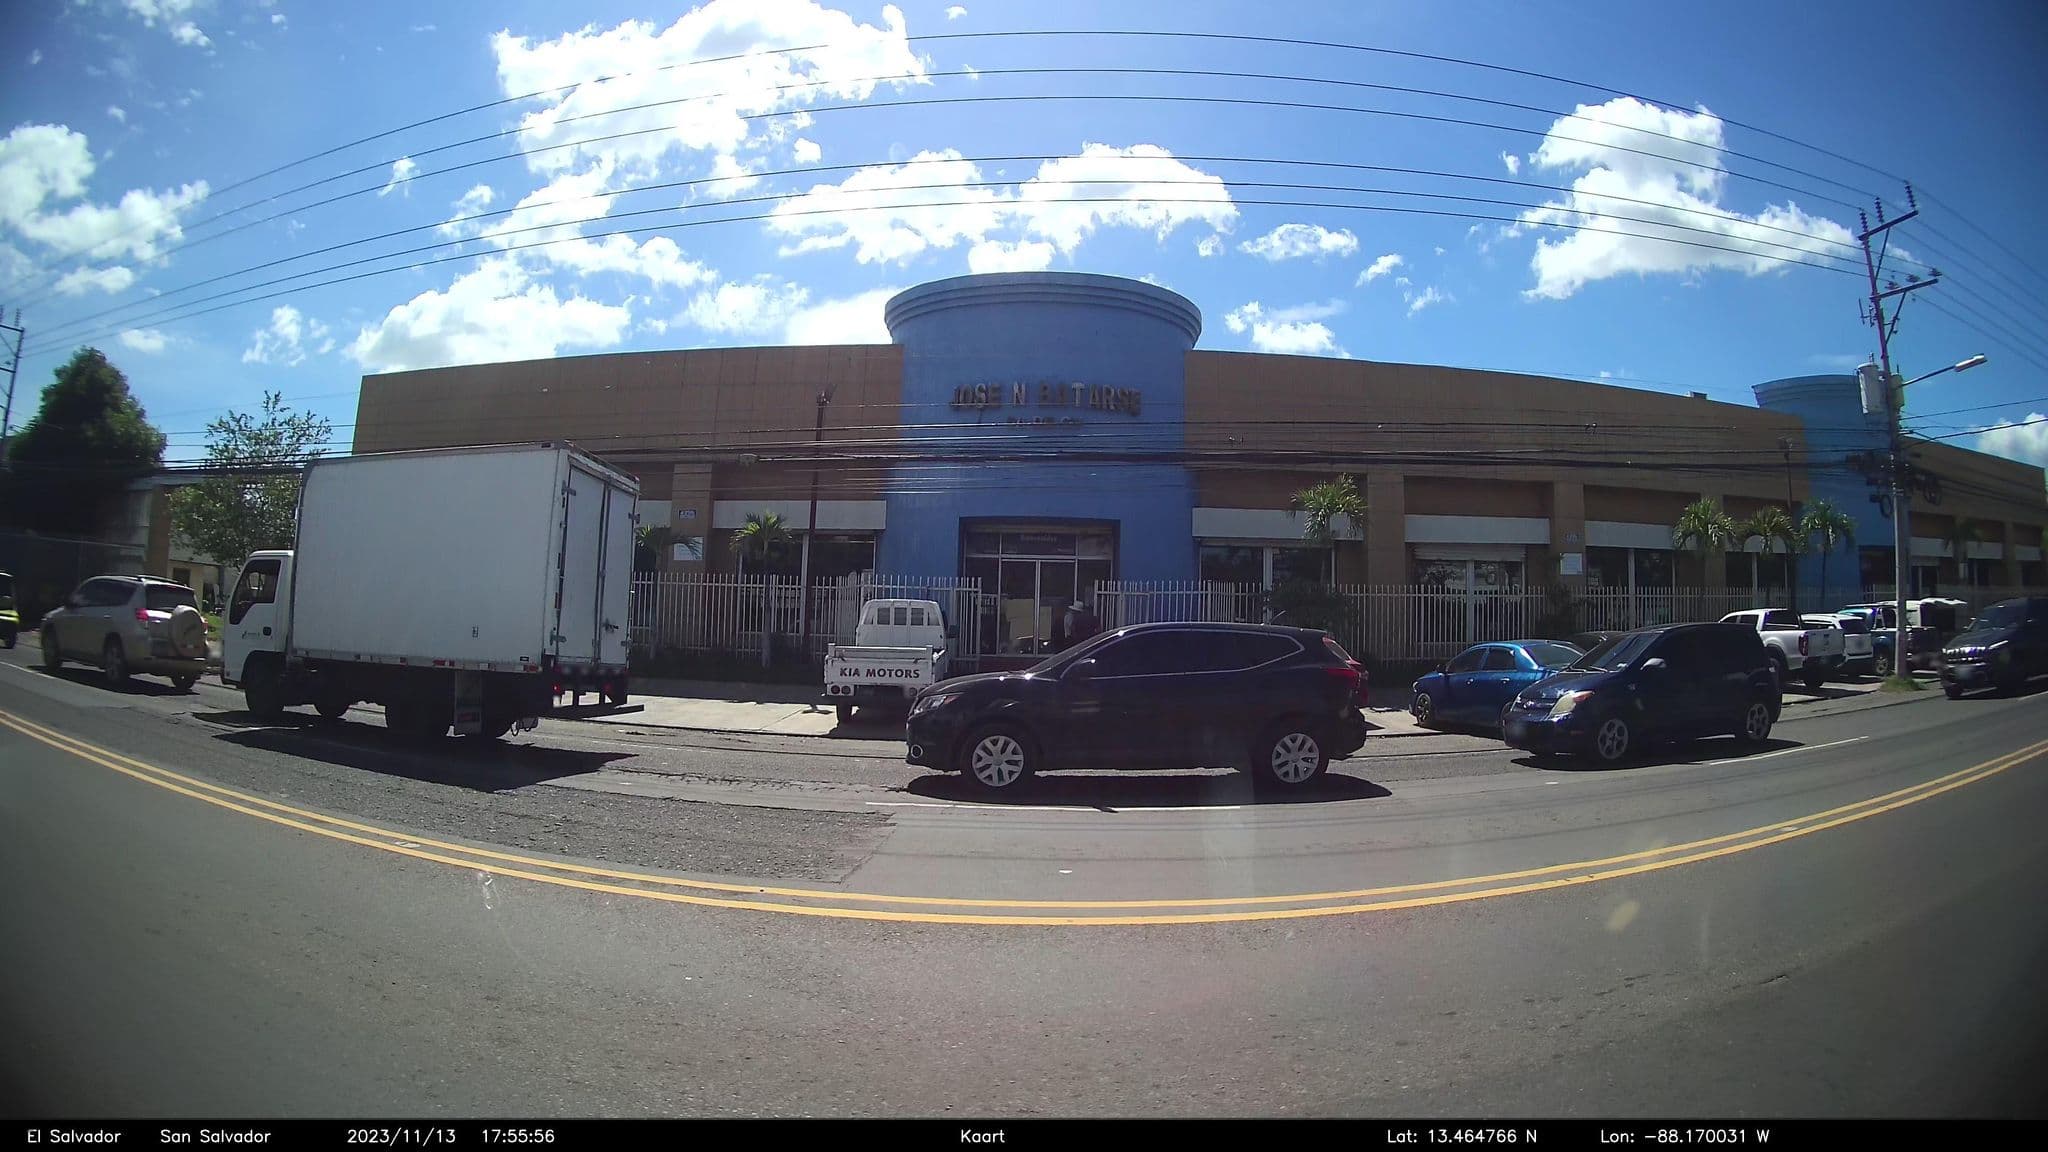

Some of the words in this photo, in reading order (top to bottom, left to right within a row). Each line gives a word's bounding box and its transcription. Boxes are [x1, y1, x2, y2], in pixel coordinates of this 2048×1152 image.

[1013, 381, 1027, 407] N
[840, 667, 861, 677] KIA
[865, 668, 920, 679] MOTORS
